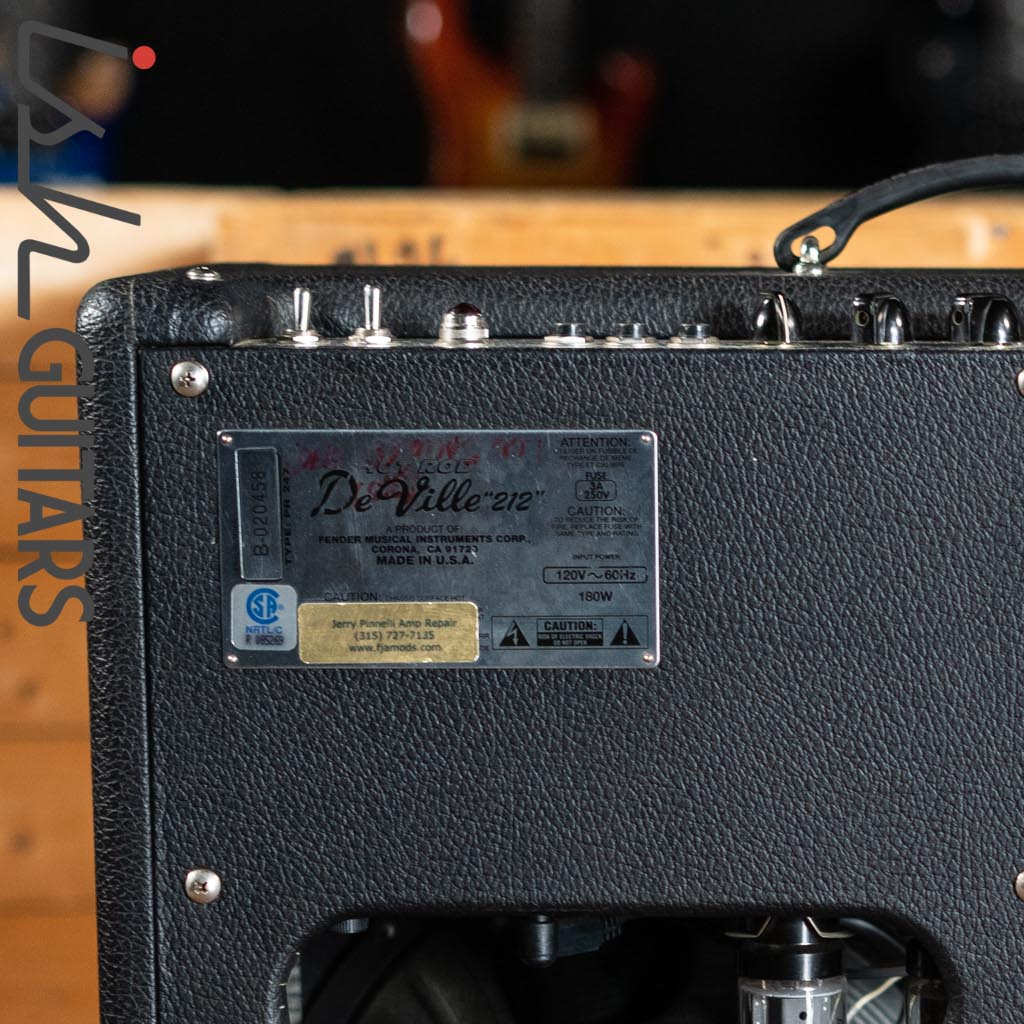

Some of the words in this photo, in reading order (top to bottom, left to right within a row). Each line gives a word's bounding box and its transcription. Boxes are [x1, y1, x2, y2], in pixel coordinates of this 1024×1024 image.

[250, 470, 269, 556] B-020458
[396, 525, 444, 534] PRODUCT
[319, 536, 362, 544] FENDER
[365, 536, 412, 544] MUSICAL
[416, 535, 493, 544] INSTRUMENTS
[427, 545, 441, 554] CA
[376, 556, 414, 565] MADE
[419, 556, 431, 565] IN
[436, 556, 474, 565] U.S.A.
[578, 591, 613, 601] 180W
[332, 619, 356, 630] Jerry
[399, 619, 421, 630] Amp
[425, 618, 457, 630] Repair
[544, 621, 597, 631] CAUTION:
[354, 631, 382, 641] (315)
